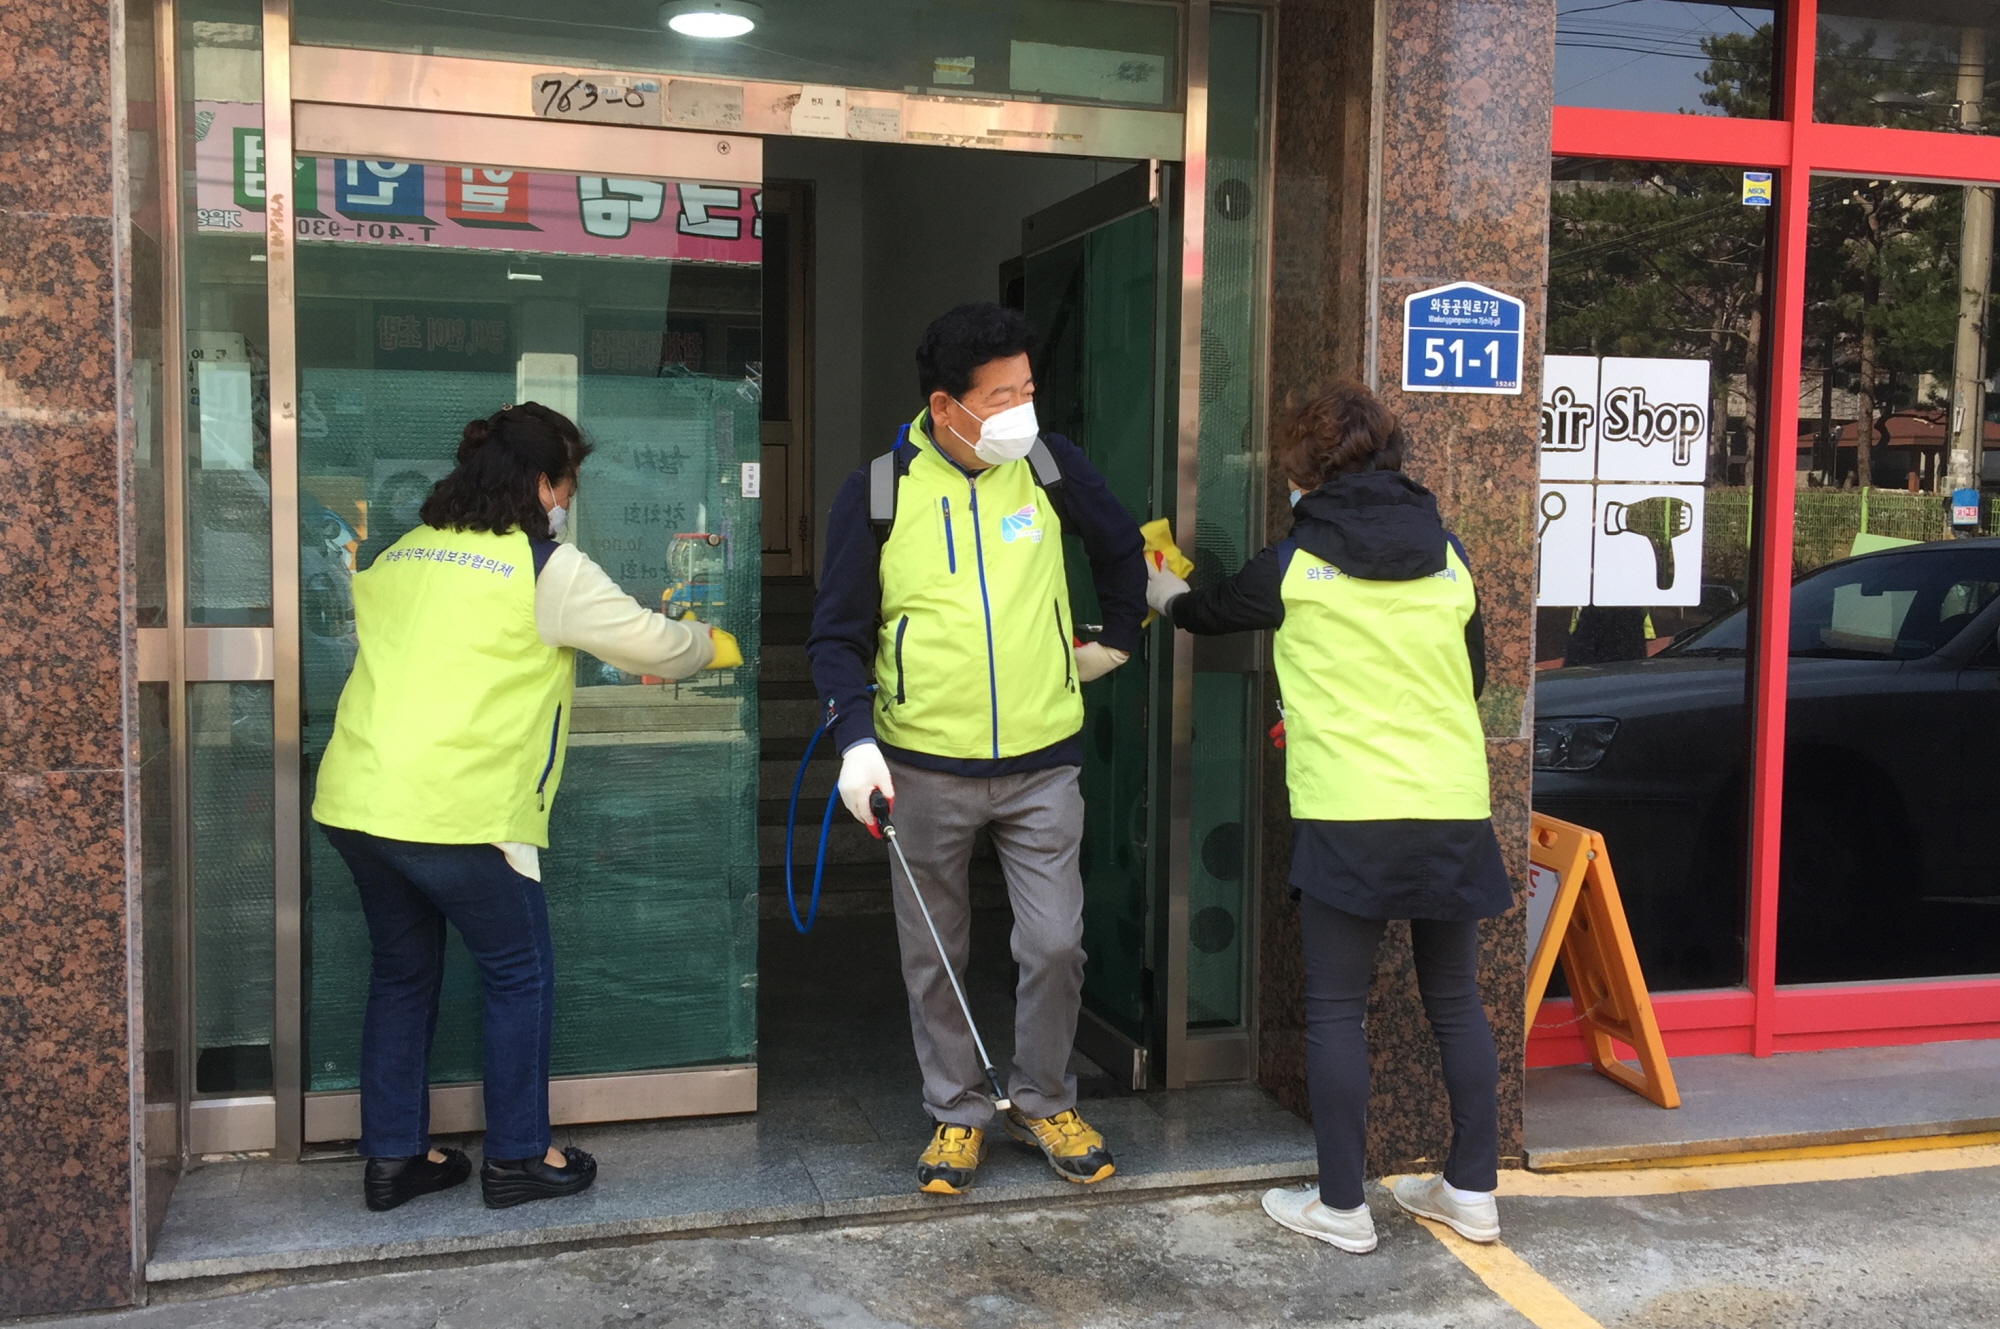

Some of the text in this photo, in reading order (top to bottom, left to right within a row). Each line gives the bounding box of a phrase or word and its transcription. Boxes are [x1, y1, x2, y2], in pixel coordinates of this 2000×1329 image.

[541, 78, 645, 116] 763-0
[1430, 298, 1499, 316] 와동공원로7길
[1424, 337, 1500, 379] 51-1
[1495, 380, 1516, 388] 15245
[1602, 387, 1705, 466] Shop
[384, 547, 515, 579] 와동지역사회보장협의체
